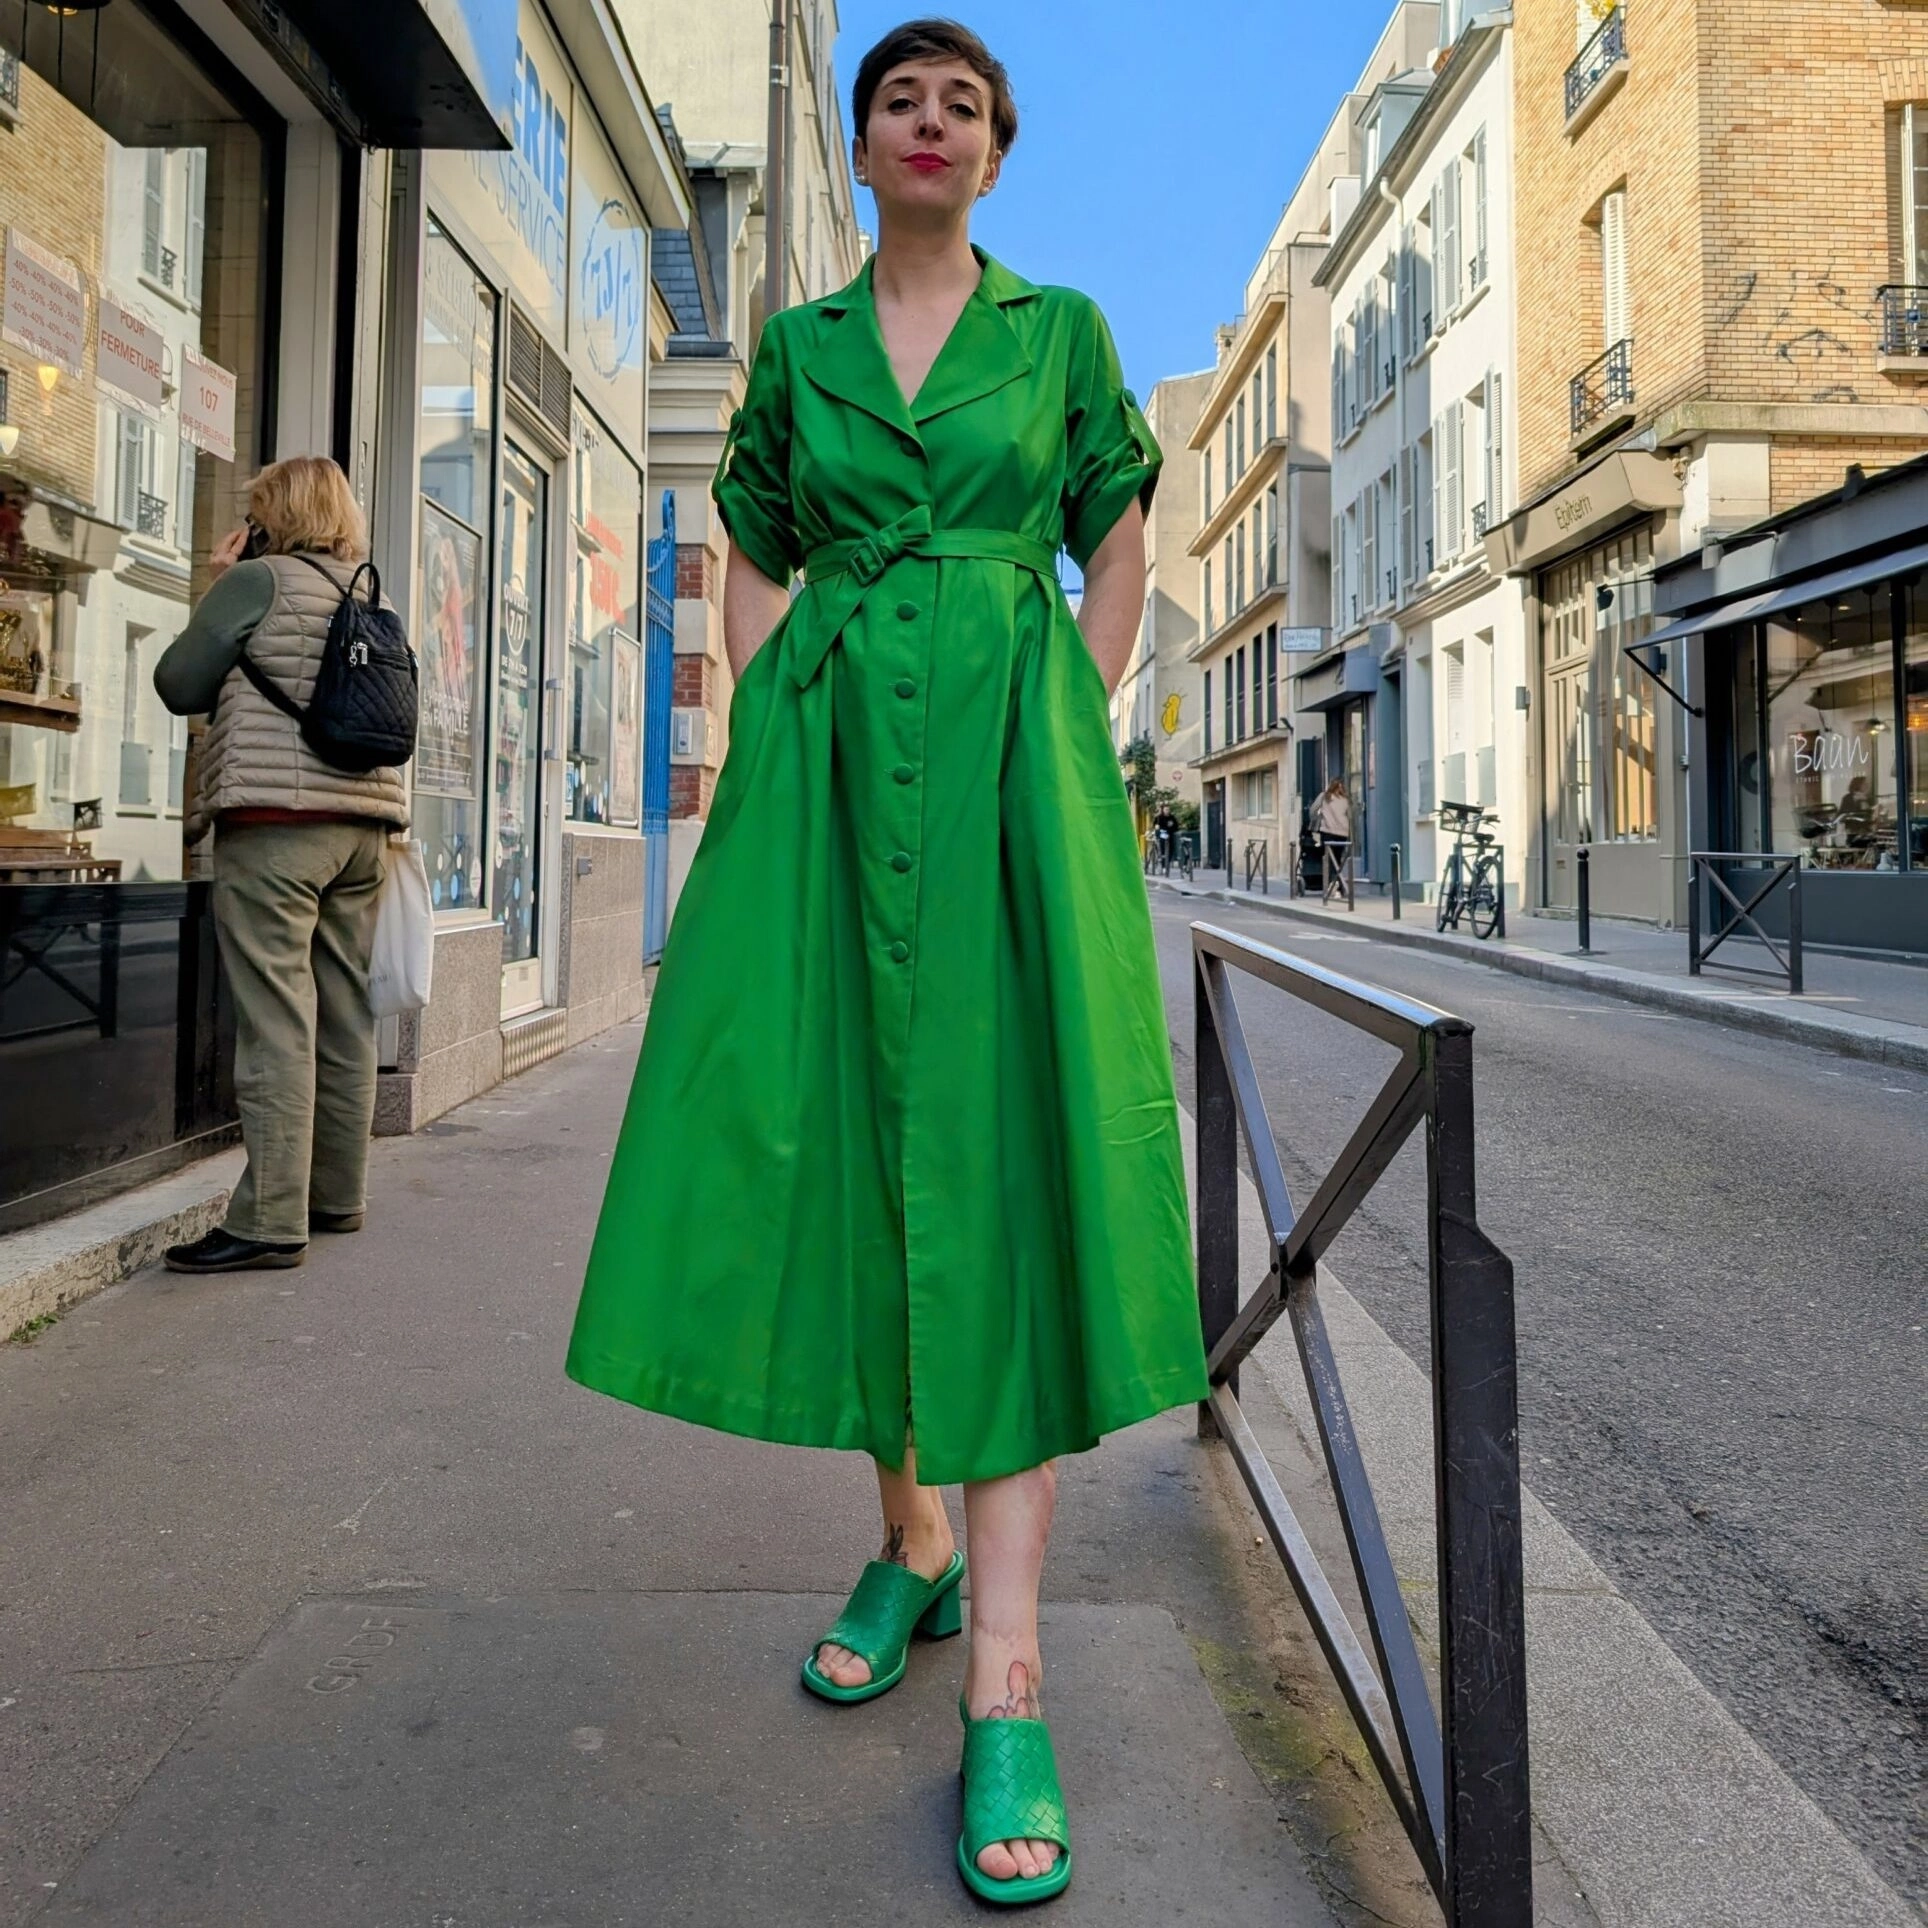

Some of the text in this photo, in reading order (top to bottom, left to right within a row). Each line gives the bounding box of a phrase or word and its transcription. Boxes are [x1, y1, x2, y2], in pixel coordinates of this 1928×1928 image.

[495, 150, 564, 297] SERVICE
[120, 310, 145, 338] POUR
[101, 329, 160, 380] FERMETURE
[200, 386, 218, 412] 107
